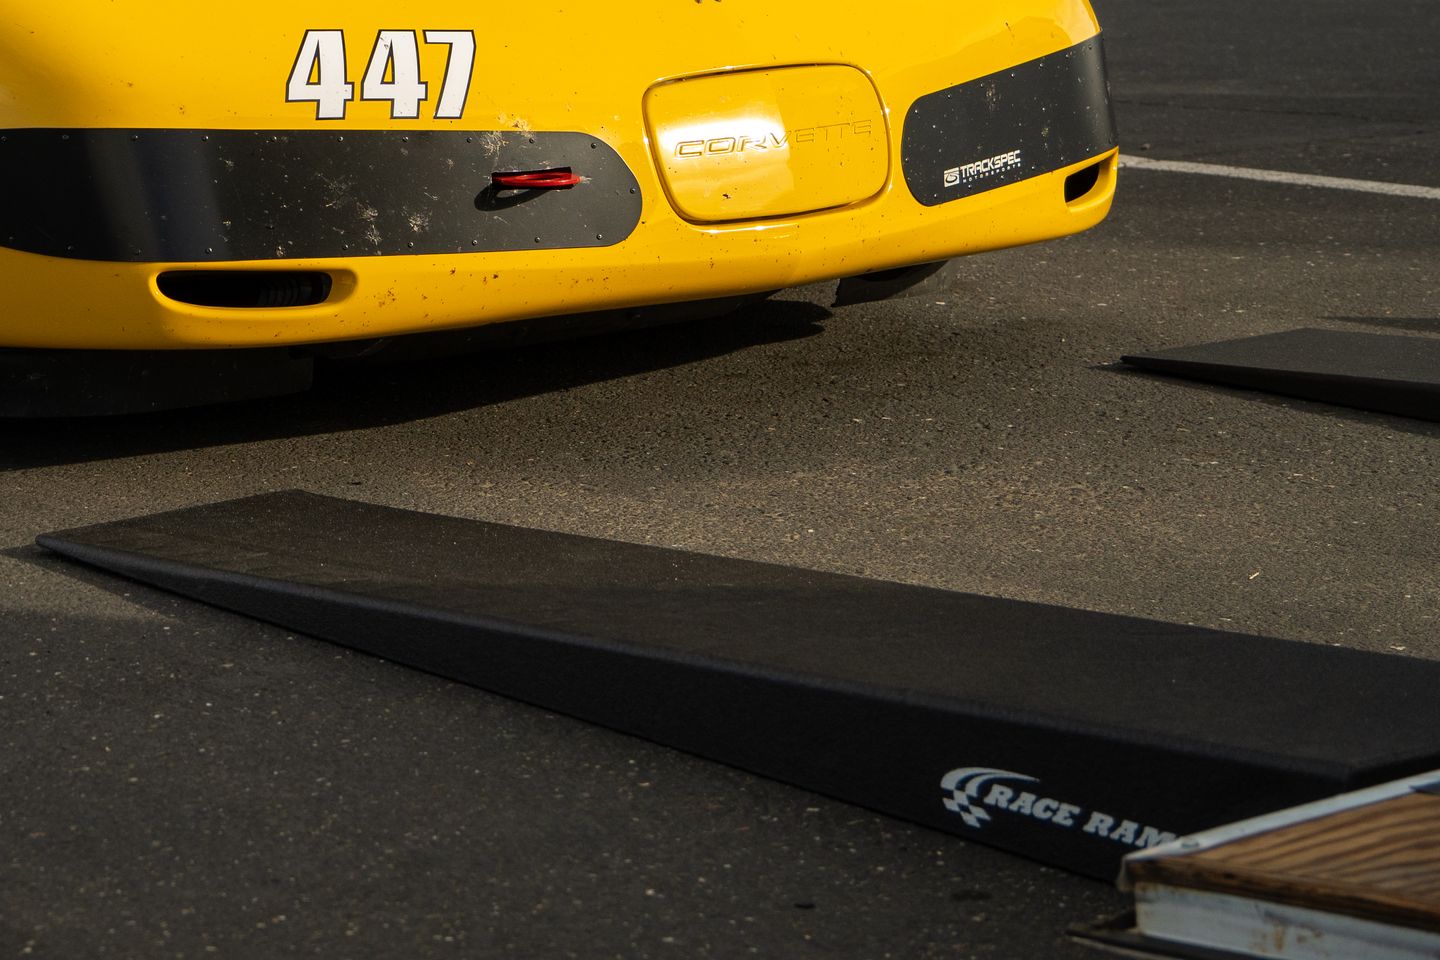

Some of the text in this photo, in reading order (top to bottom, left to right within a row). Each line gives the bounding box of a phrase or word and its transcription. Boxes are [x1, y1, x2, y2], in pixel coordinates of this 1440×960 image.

[285, 29, 476, 120] 447
[675, 119, 872, 159] CORVETTE
[960, 149, 1021, 178] TRACKSPEC
[983, 784, 1080, 827] RACE
